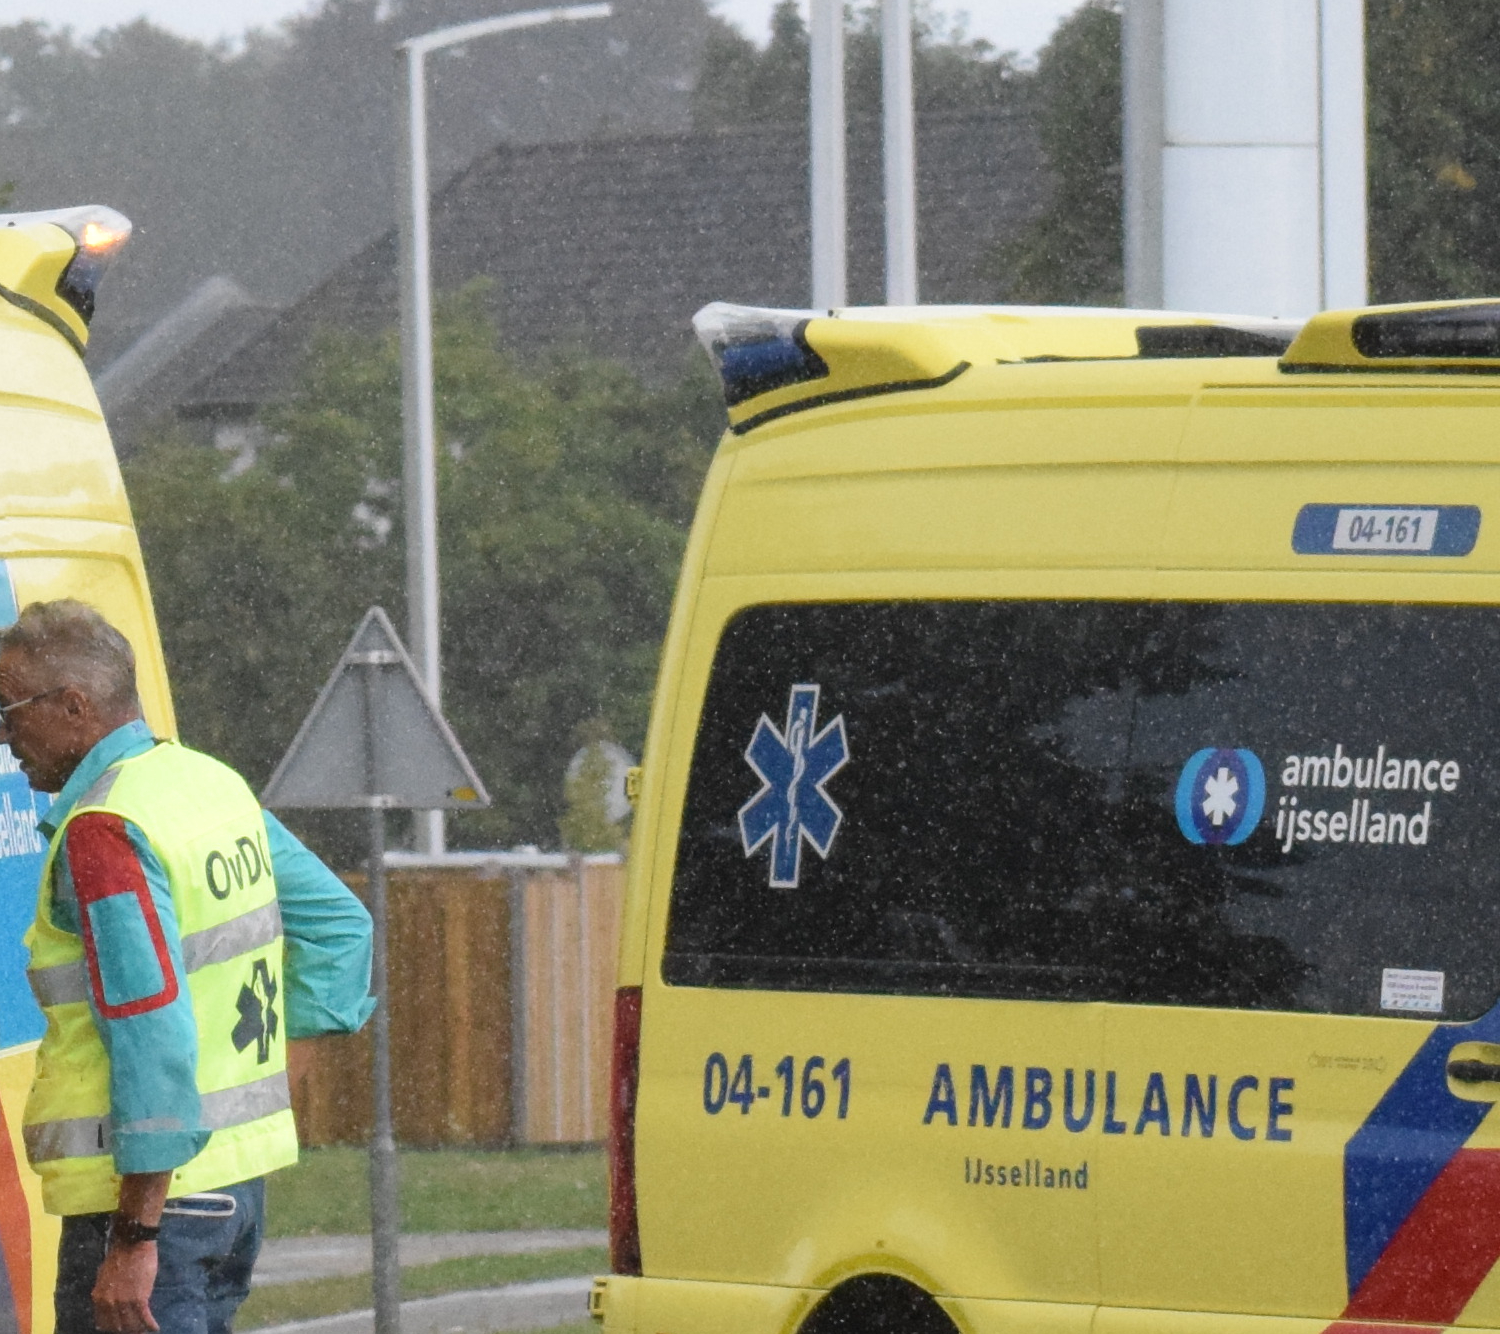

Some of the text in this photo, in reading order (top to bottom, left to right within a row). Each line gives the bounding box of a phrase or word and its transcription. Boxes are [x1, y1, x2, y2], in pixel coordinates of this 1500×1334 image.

[1349, 515, 1423, 543] 04-161
[1282, 743, 1460, 791] ambulance
[1275, 795, 1431, 854] ijsselland
[702, 1051, 851, 1120] 04-161
[922, 1063, 1295, 1142] AMBULANCE
[964, 1157, 1089, 1190] IJsselland
